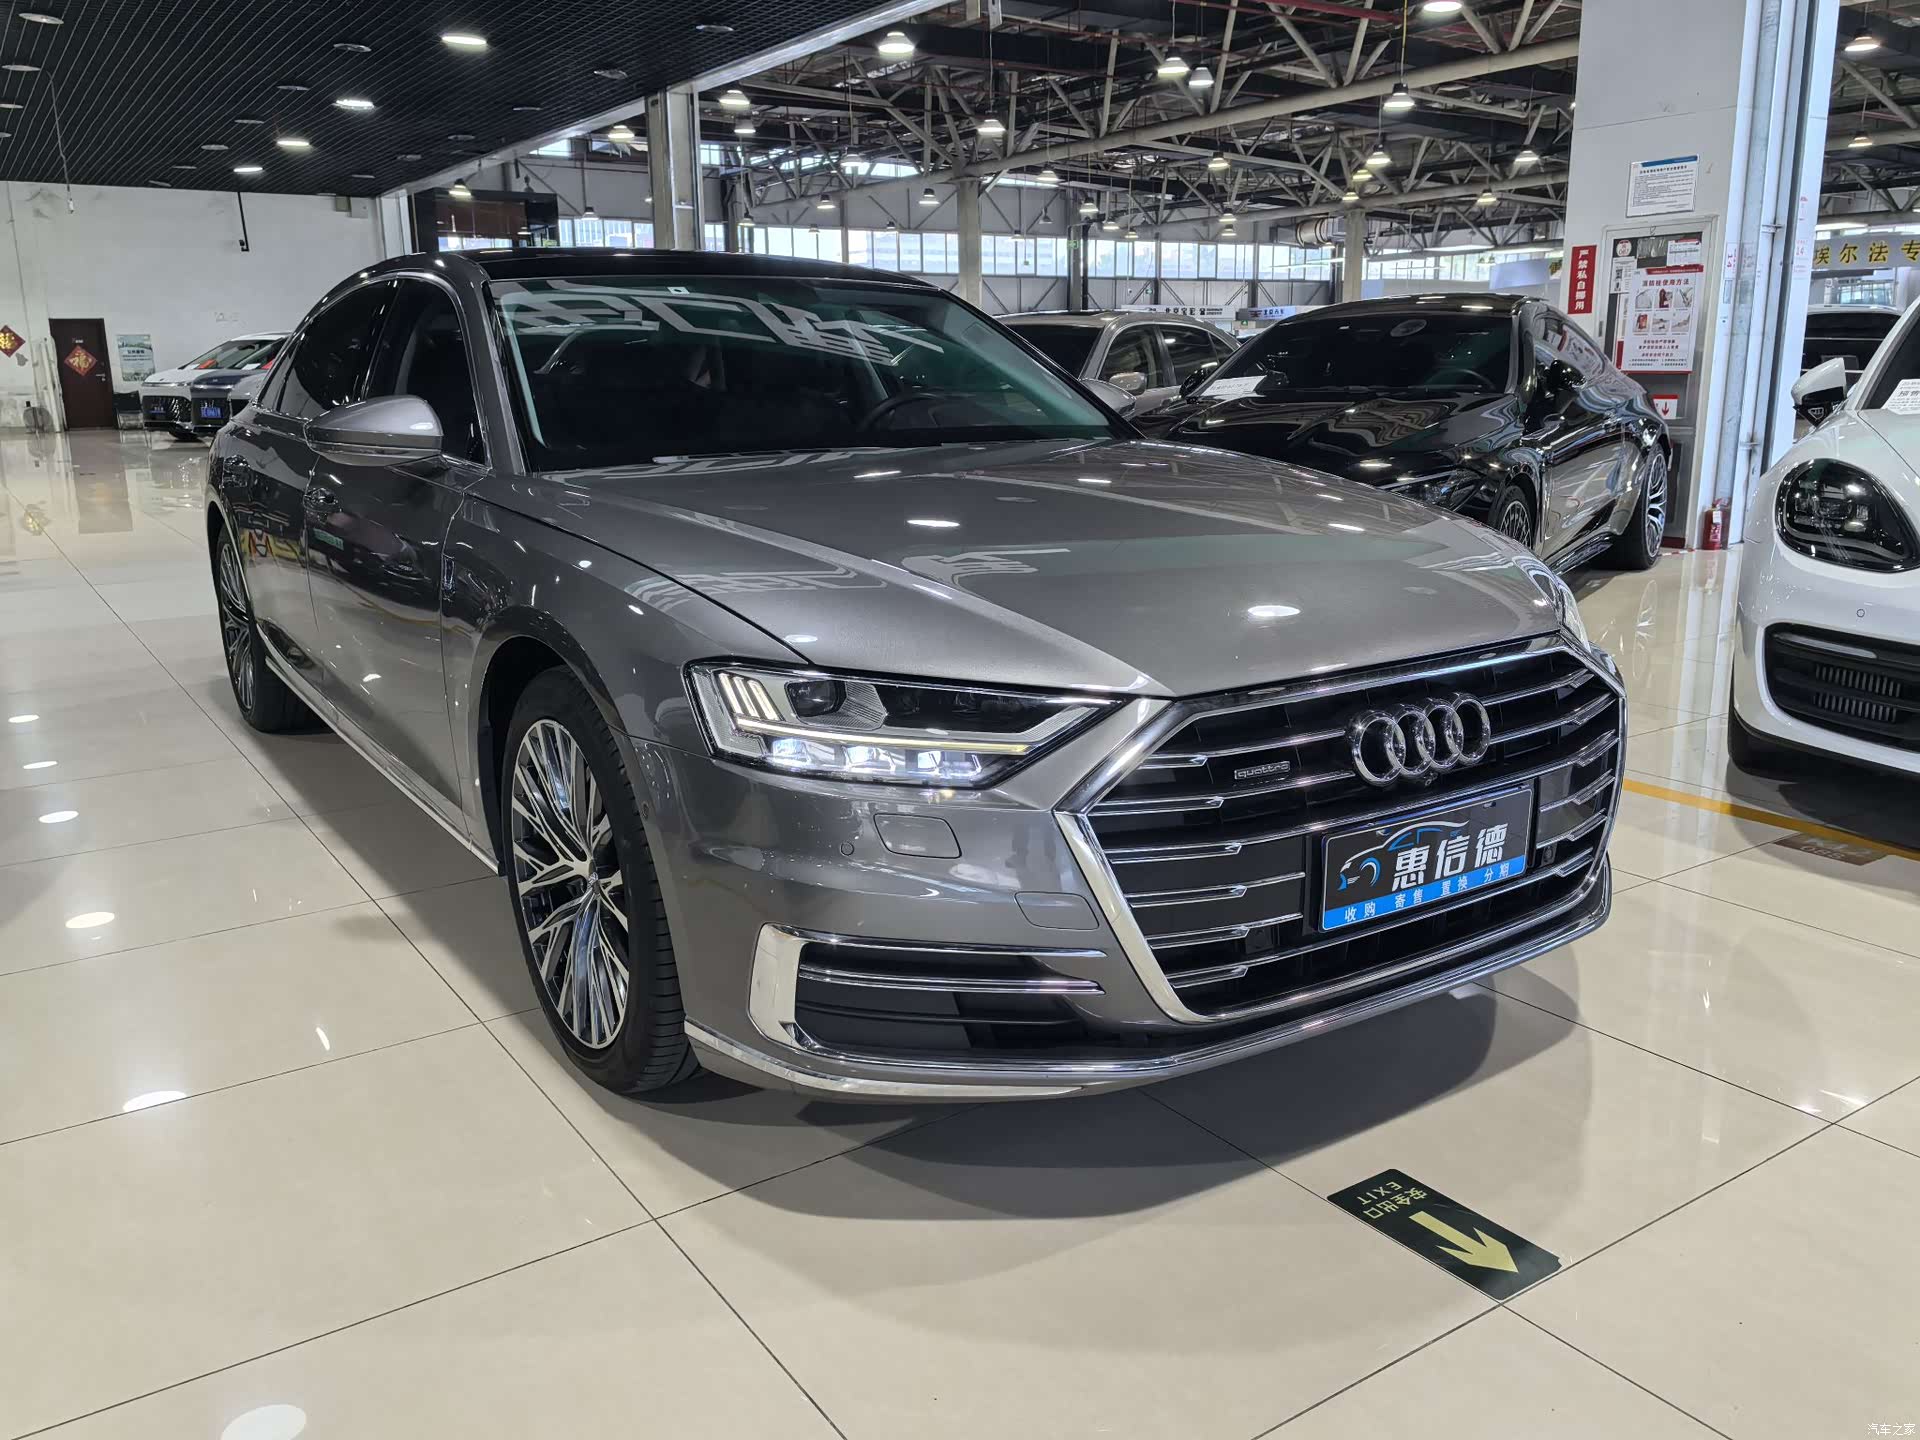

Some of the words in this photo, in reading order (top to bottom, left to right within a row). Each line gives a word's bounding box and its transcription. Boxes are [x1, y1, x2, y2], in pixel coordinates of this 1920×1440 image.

[68, 349, 93, 370] 福
[1237, 763, 1289, 778] quattro
[1392, 823, 1508, 890] 惠信德
[1344, 902, 1377, 923] 收购
[1394, 889, 1424, 909] 寄售
[1440, 877, 1469, 897] 置换
[1483, 862, 1511, 883] 分期
[1357, 1182, 1402, 1205] EXIT
[1364, 1188, 1427, 1219] 安全出口
